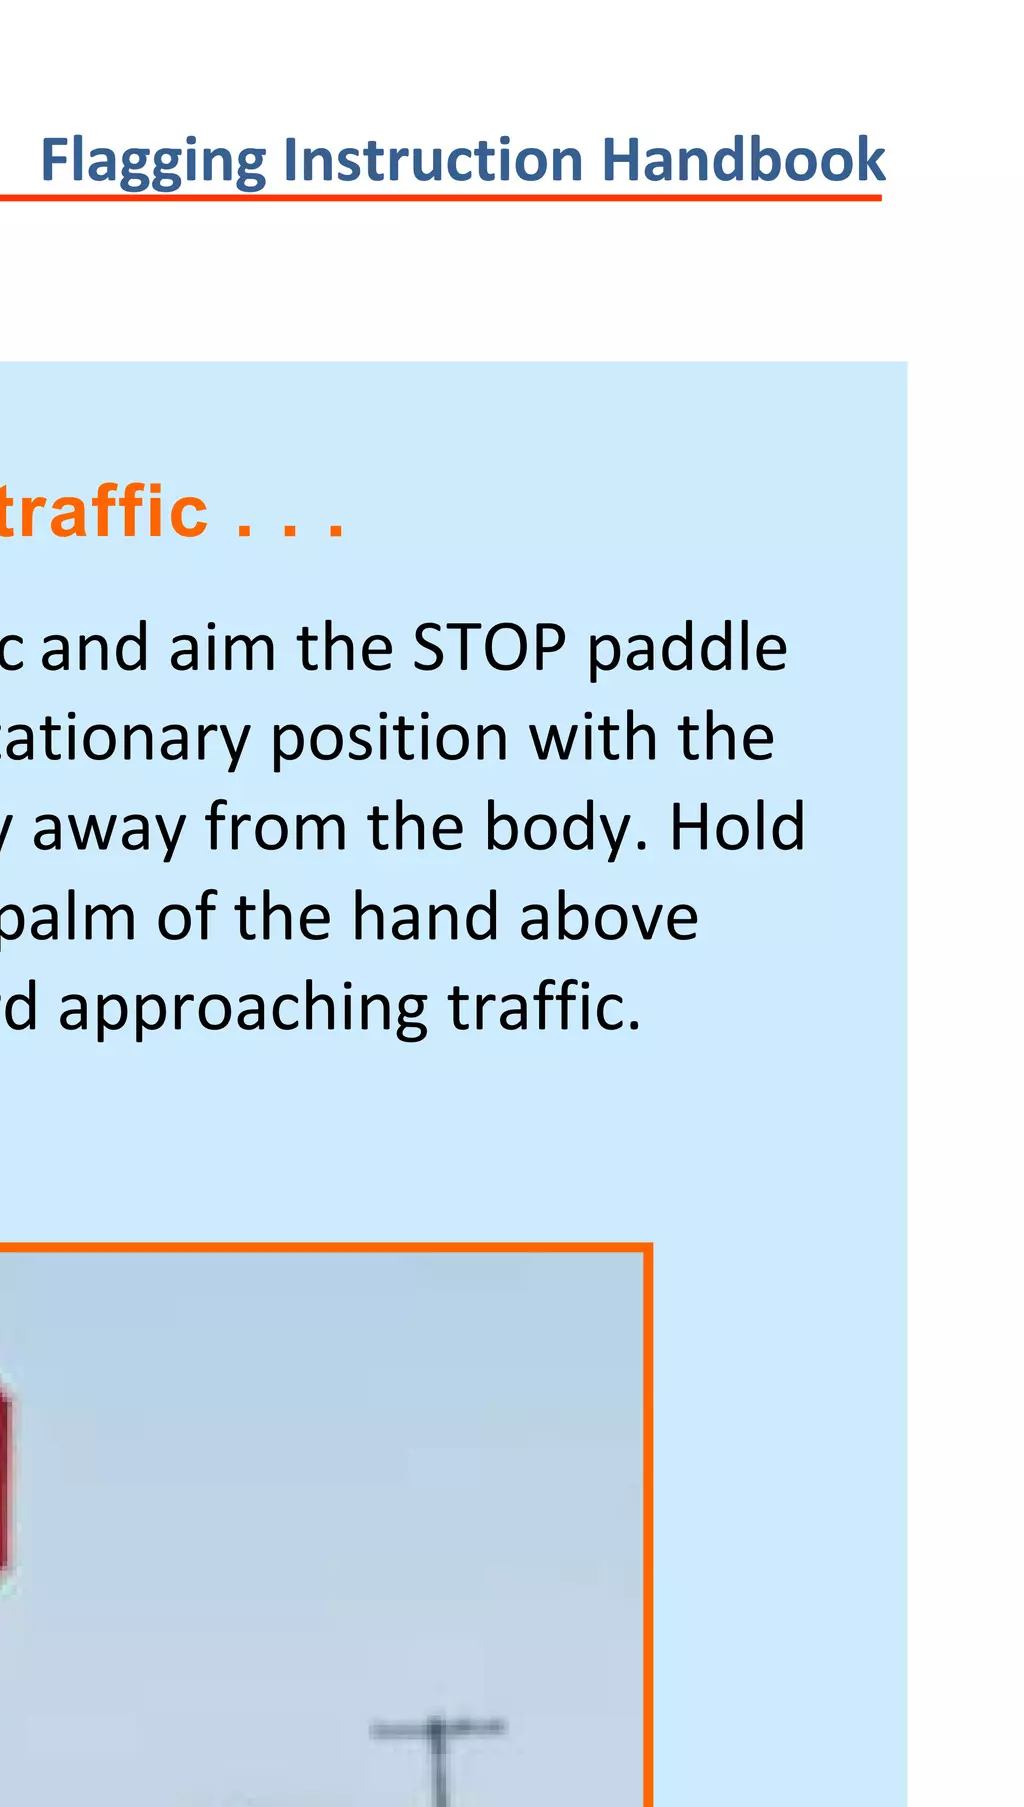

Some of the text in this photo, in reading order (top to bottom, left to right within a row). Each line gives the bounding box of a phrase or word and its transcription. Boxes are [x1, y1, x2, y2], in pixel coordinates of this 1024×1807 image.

[42, 134, 887, 193] Flagging Instruction Handbook
[41, 619, 147, 672] and
[170, 621, 275, 672] aim
[295, 618, 393, 672] the
[413, 621, 566, 672] STOP
[589, 618, 787, 684] paddle
[273, 710, 507, 774] position
[528, 708, 656, 761] with
[676, 708, 774, 761] the
[33, 813, 187, 864] away
[204, 798, 346, 851] from
[366, 798, 464, 851] the
[487, 798, 647, 864] body.
[672, 798, 804, 851] Hold
[157, 888, 219, 941] of
[233, 888, 331, 941] the
[354, 888, 497, 941] hand
[520, 888, 698, 941] above
[59, 978, 429, 1044] approaching
[446, 978, 639, 1031] traffic.
